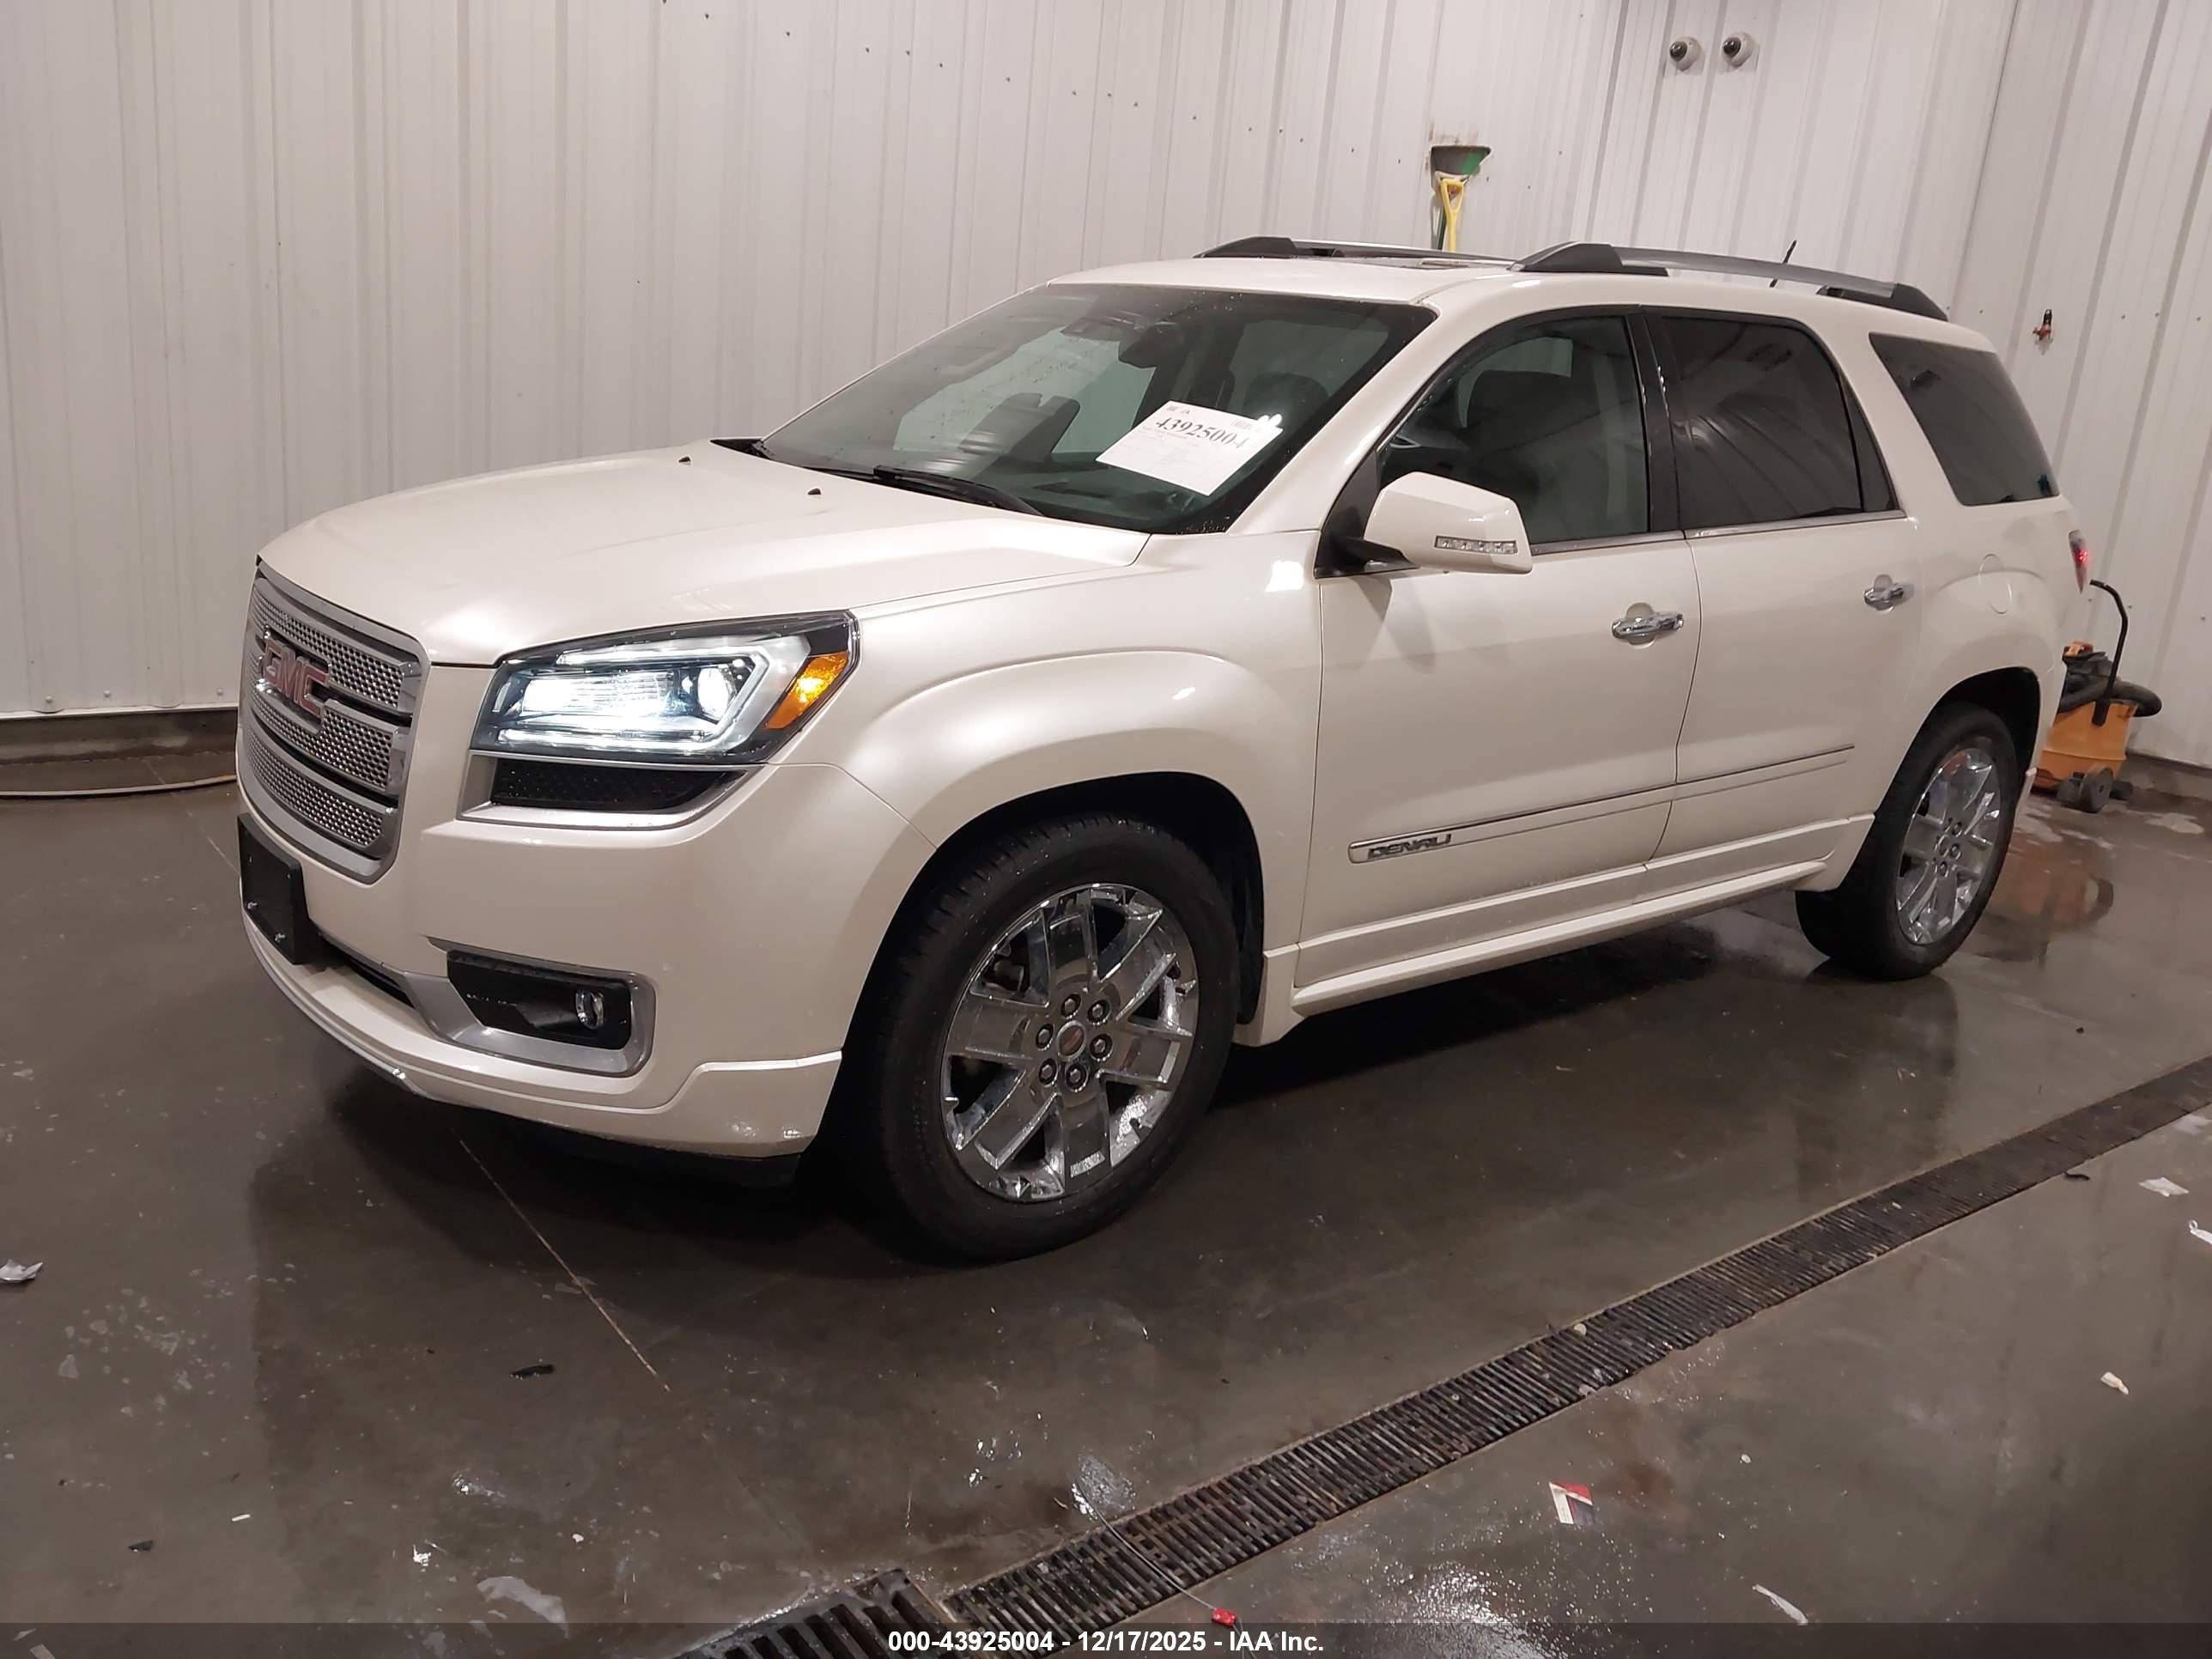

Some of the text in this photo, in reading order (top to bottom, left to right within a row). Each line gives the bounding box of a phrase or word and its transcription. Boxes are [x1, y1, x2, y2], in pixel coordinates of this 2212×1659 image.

[1156, 417, 1249, 448] 43925004
[260, 637, 329, 717] GMC
[1367, 833, 1452, 860] DENALI
